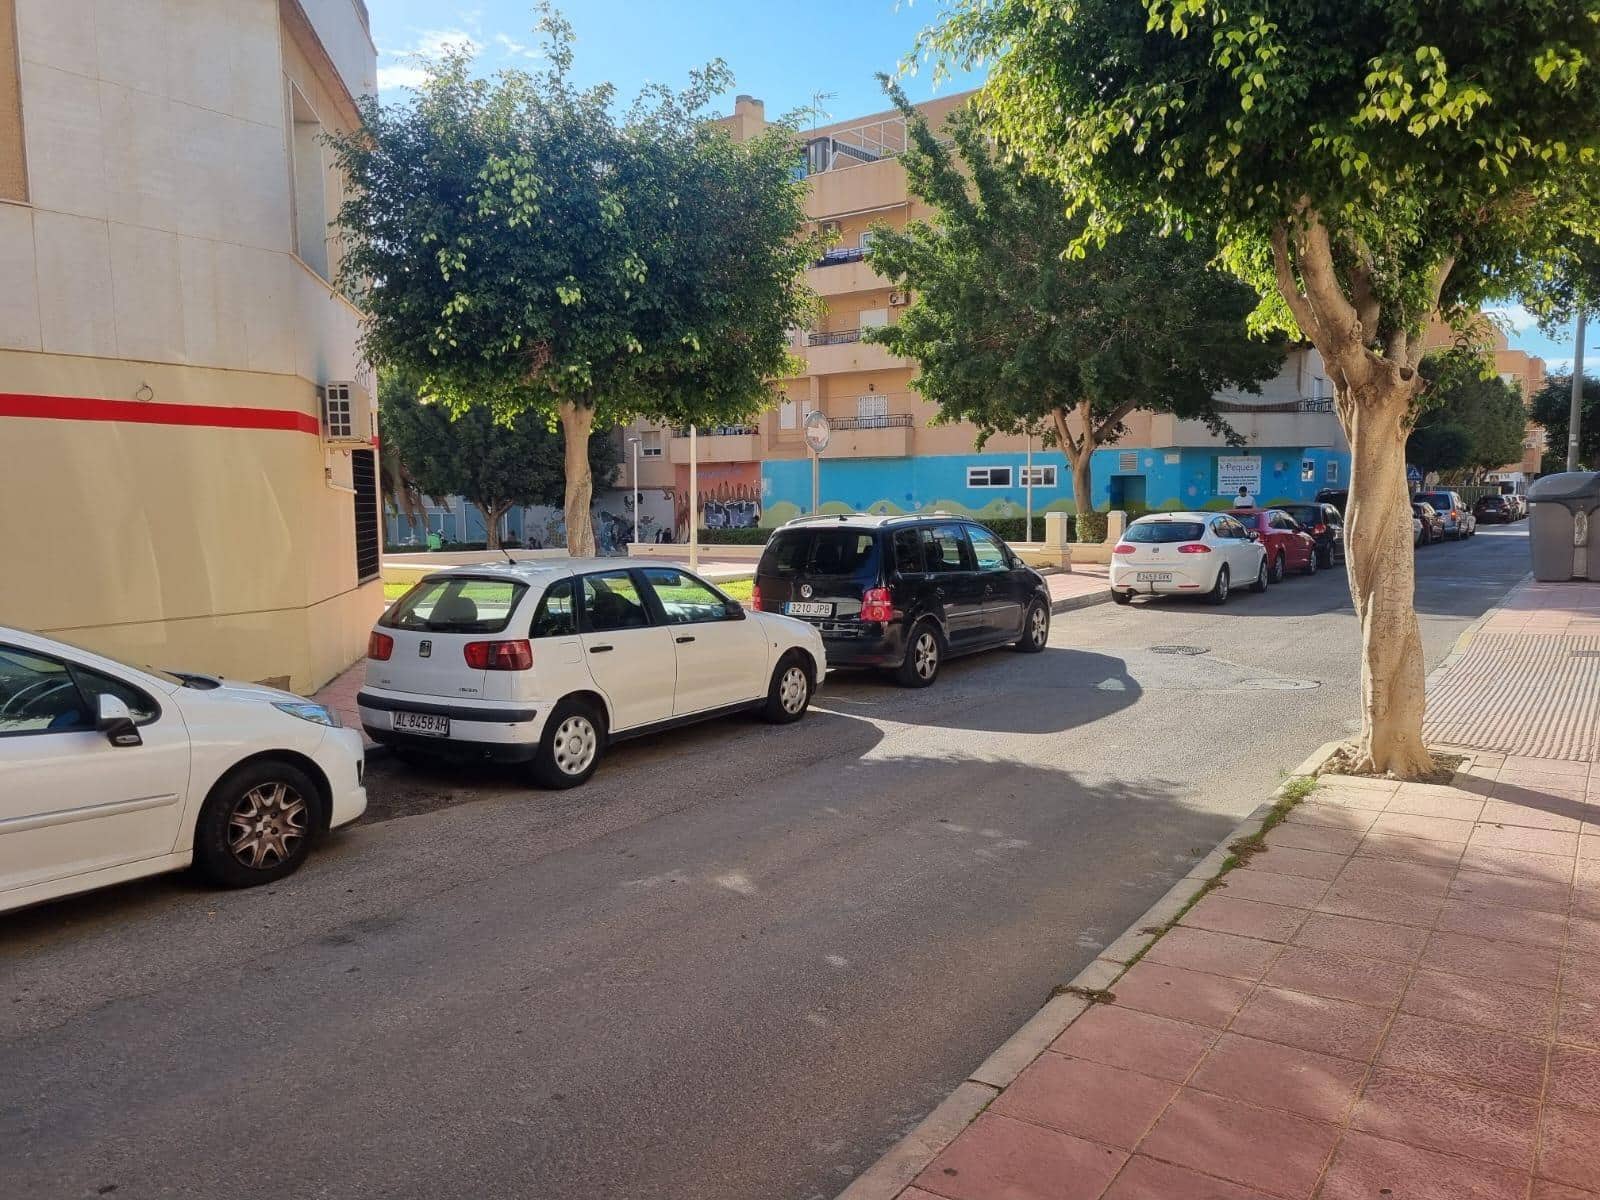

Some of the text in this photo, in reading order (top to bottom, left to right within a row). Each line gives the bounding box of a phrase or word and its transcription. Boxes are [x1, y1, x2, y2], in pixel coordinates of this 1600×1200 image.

[1225, 462, 1254, 472] Peques
[791, 603, 812, 613] 3210
[814, 603, 830, 614] JPB
